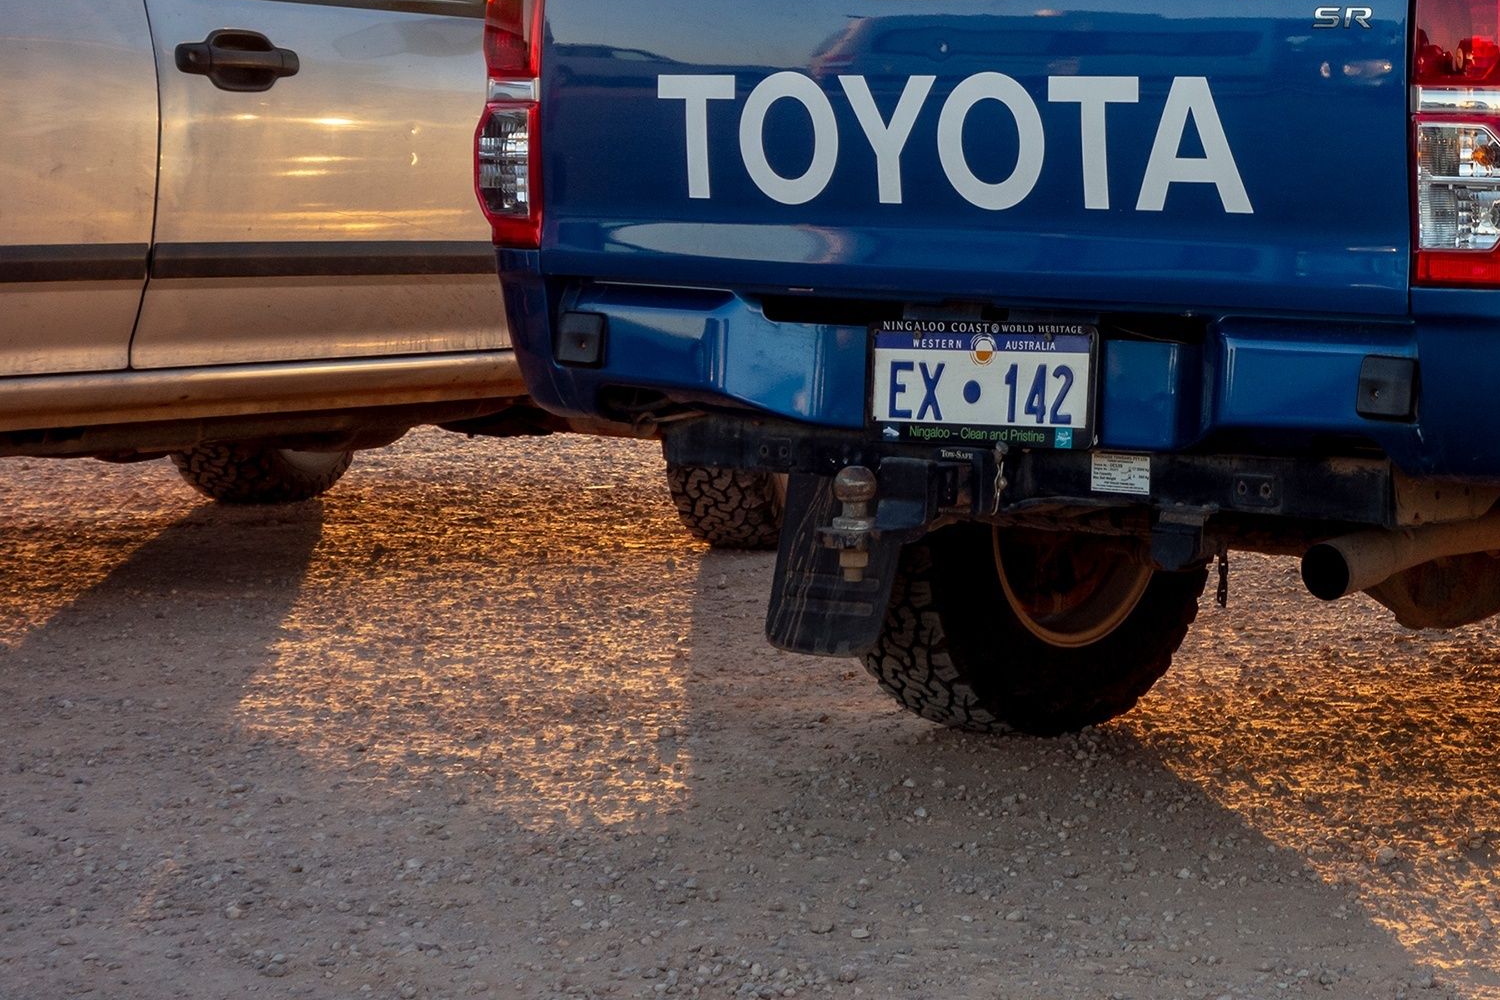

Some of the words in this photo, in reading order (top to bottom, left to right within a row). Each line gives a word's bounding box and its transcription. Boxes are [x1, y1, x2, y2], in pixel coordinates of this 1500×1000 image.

[1313, 7, 1373, 29] SR
[657, 71, 1254, 214] TOYOTA
[883, 320, 946, 332] NINGALOO
[950, 322, 990, 333] COAST
[1001, 324, 1034, 334] WORLD
[1038, 325, 1083, 335] HERITAGE
[912, 338, 962, 350] WESTERN
[1005, 340, 1056, 352] AUSTRALIA
[888, 360, 945, 421] EX
[1004, 363, 1075, 424] 142
[908, 425, 950, 440] Ningaloo
[960, 427, 988, 440] Clean
[989, 428, 1008, 441] and
[1010, 428, 1046, 443] Pristine
